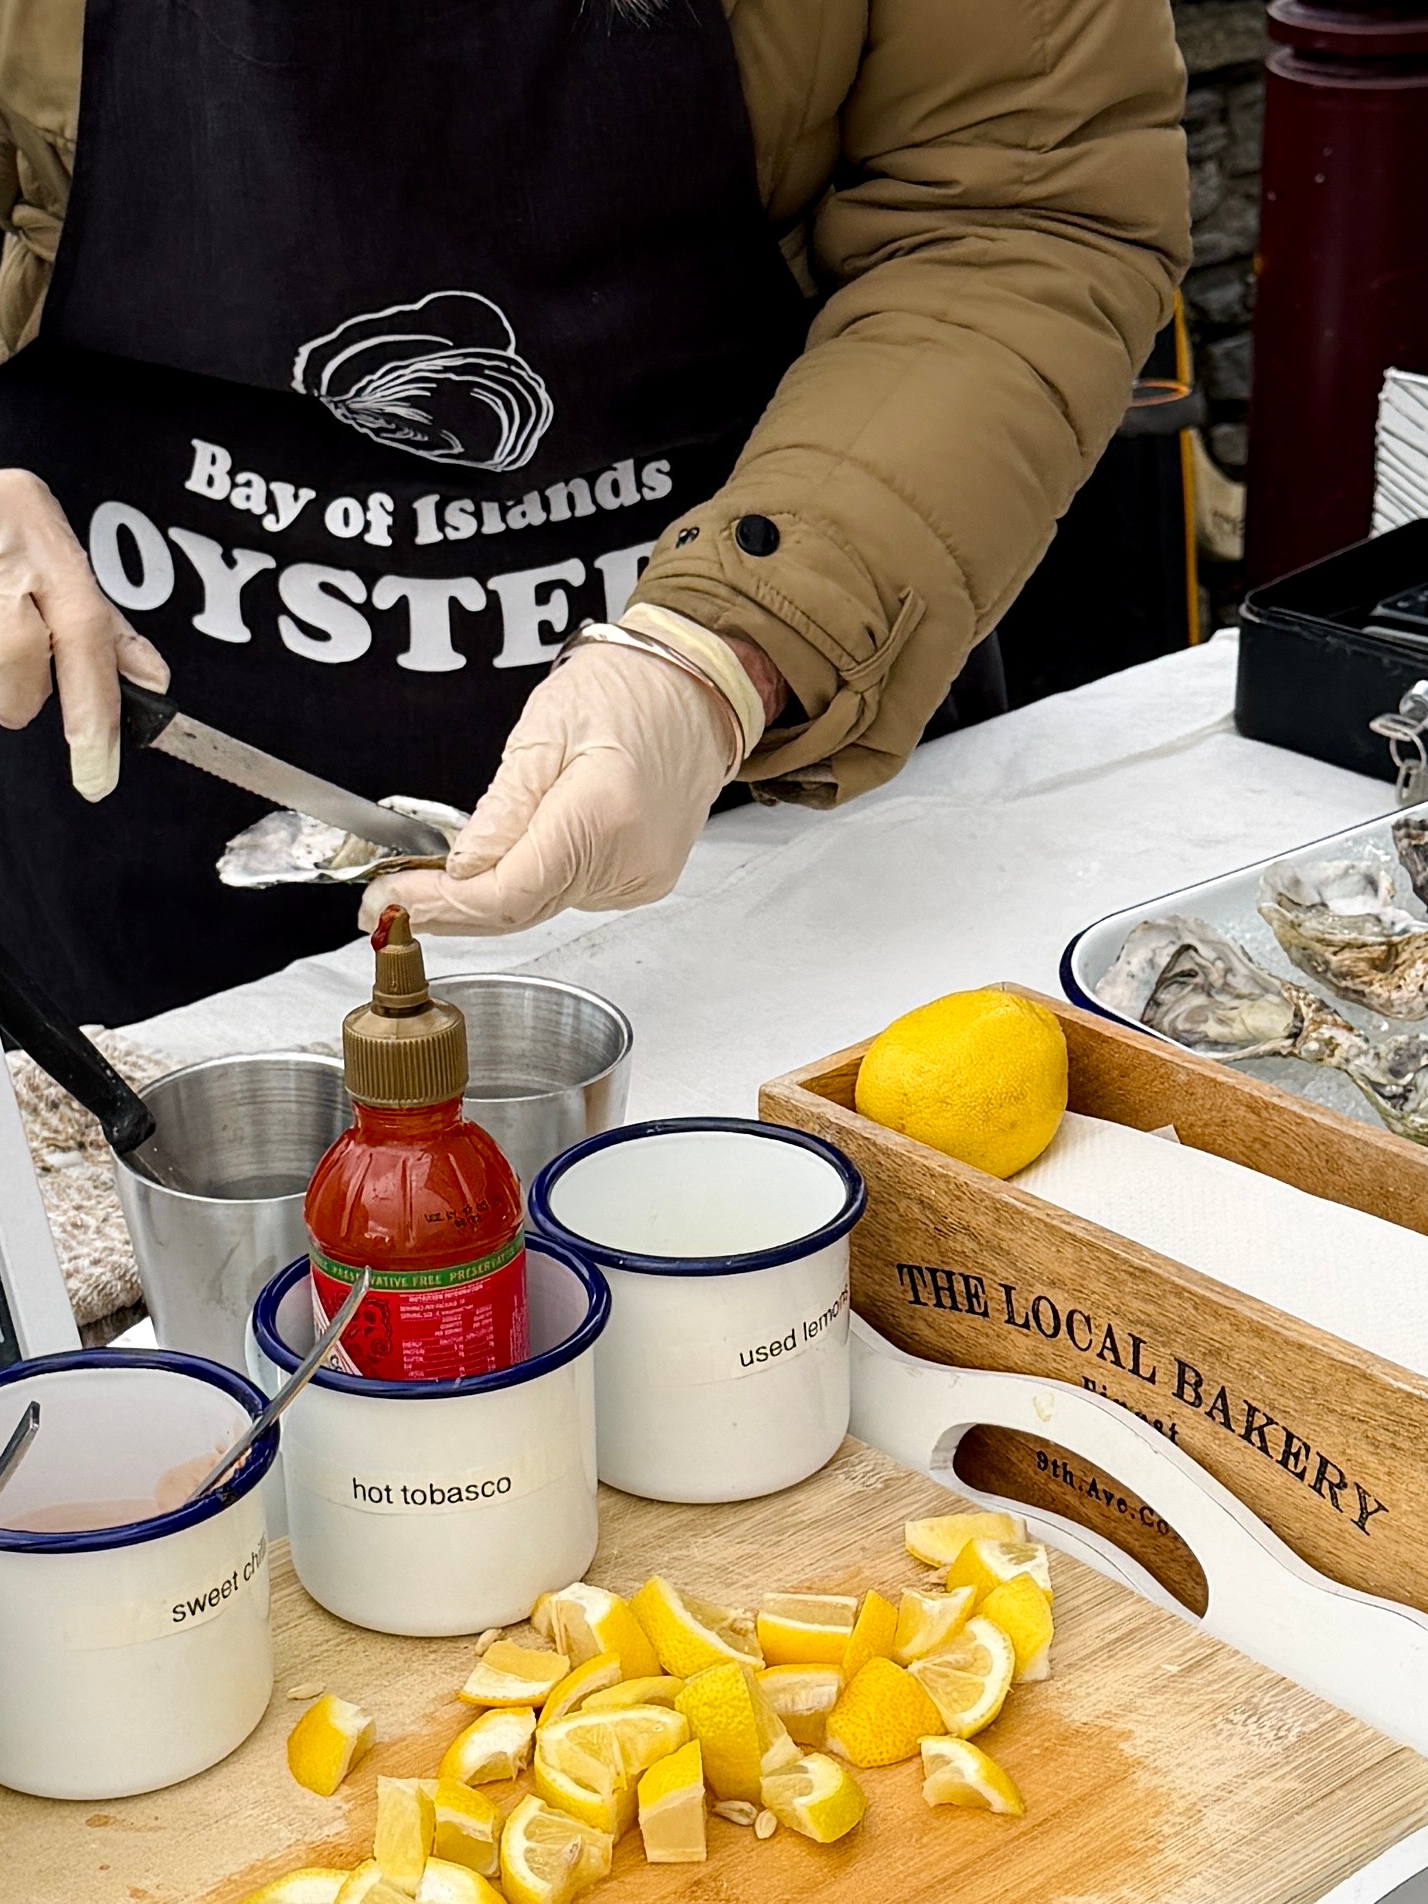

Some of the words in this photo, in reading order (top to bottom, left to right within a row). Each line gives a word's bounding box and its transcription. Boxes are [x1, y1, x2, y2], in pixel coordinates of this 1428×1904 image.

[185, 438, 316, 532] Bay
[324, 491, 394, 546] of
[412, 458, 673, 545] Islands
[739, 1328, 797, 1367] used
[896, 1264, 989, 1319] THE
[999, 1282, 1157, 1385] LOCAL
[1173, 1357, 1389, 1536] BAKERY
[352, 1477, 394, 1505] hot
[401, 1476, 512, 1506] tobasco
[172, 1571, 239, 1623] sweet
